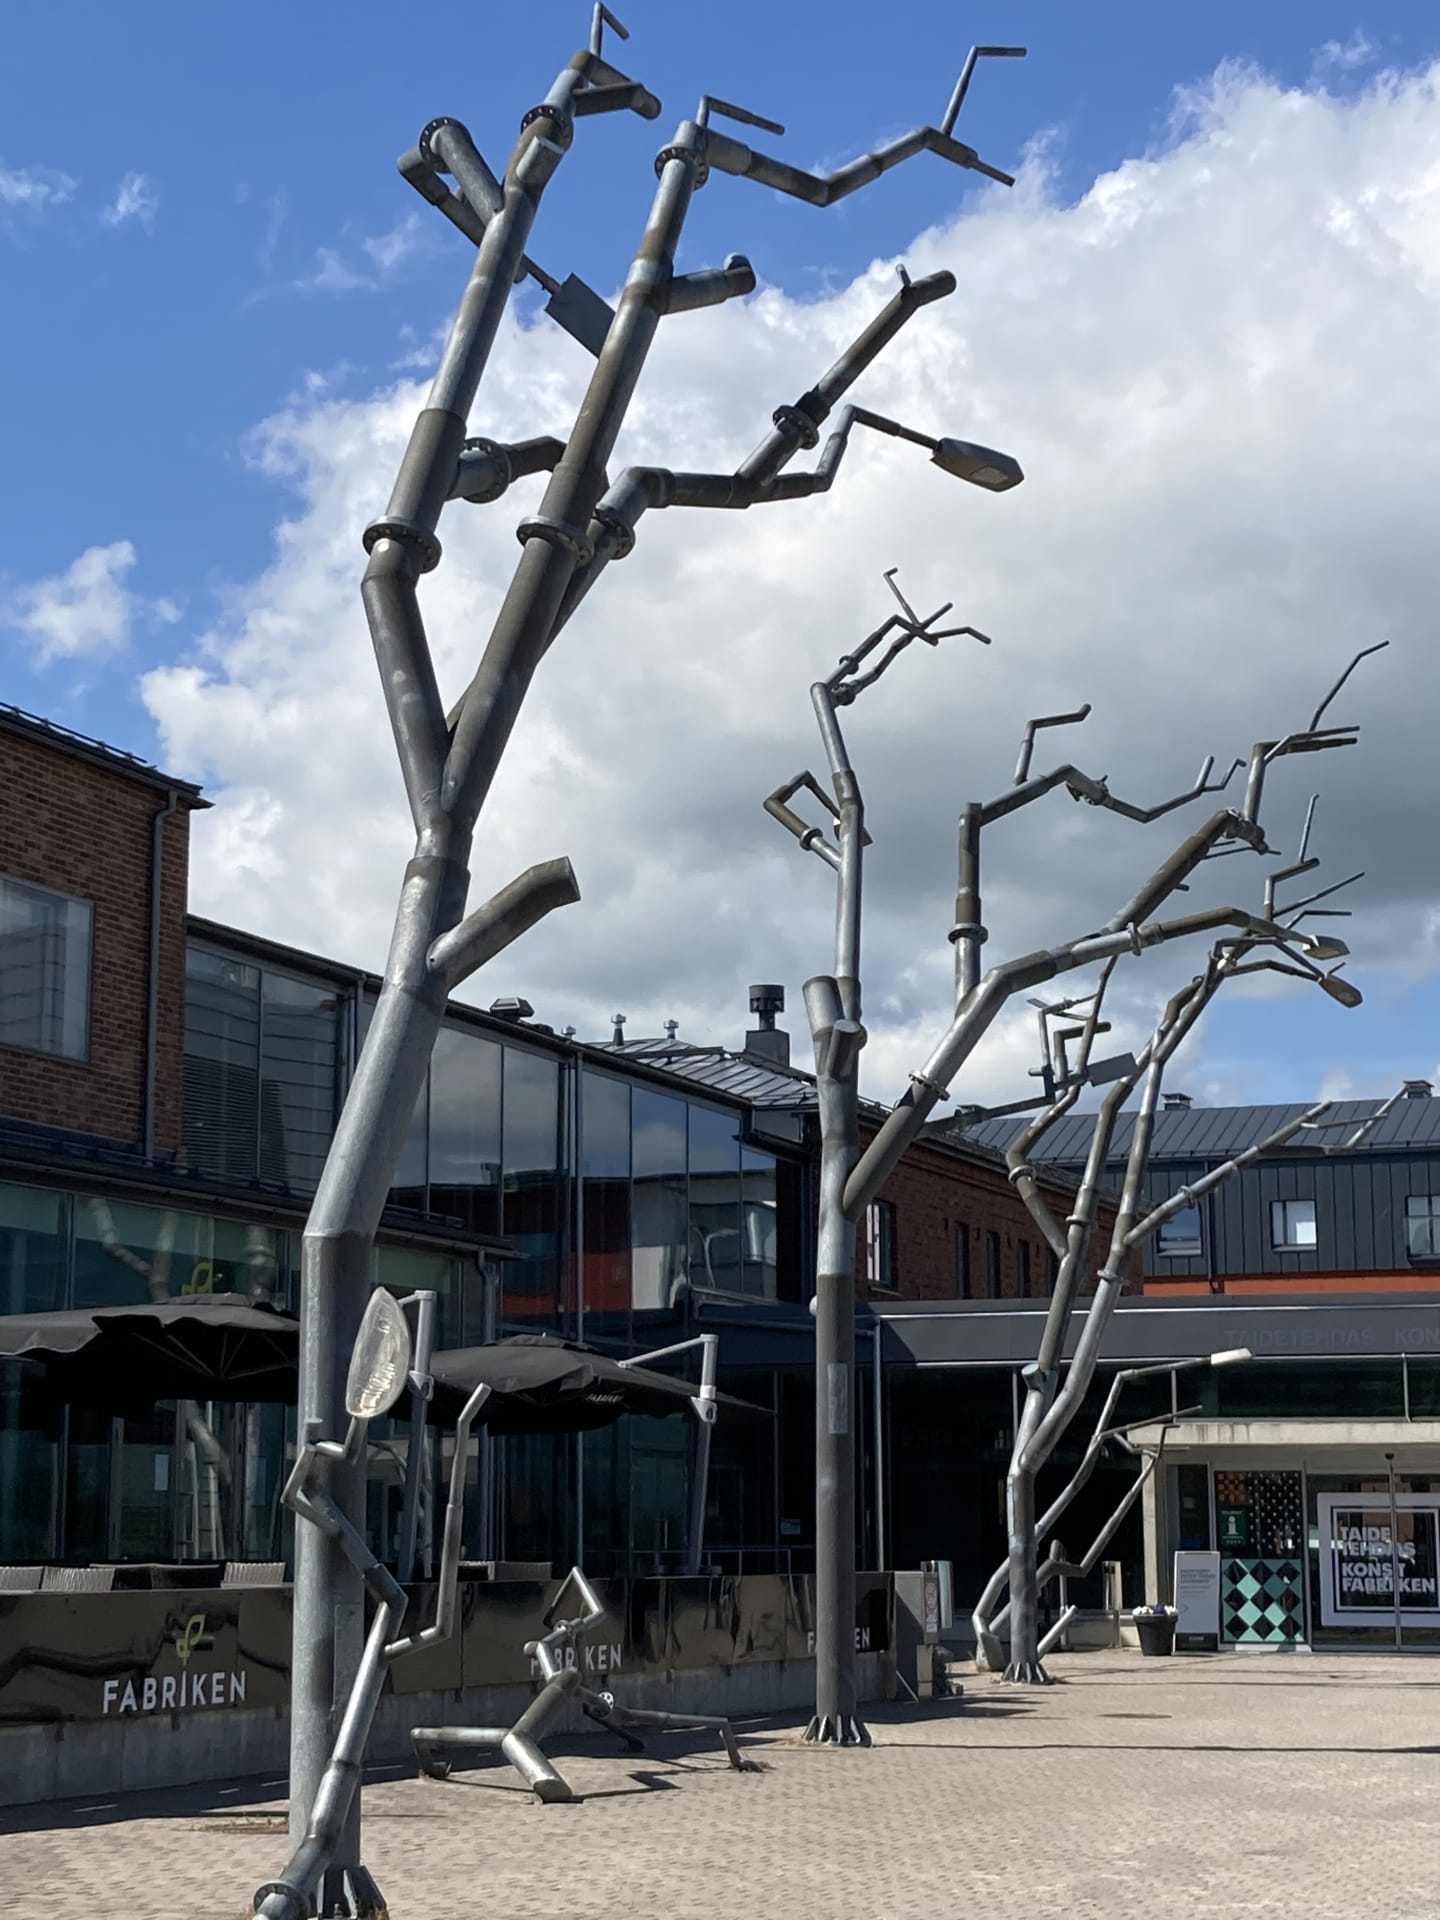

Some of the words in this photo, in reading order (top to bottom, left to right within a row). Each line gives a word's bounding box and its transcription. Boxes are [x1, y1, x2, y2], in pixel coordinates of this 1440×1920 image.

[1340, 1526, 1391, 1541] TAIDE
[1342, 1562, 1406, 1577] KONST
[1342, 1577, 1436, 1593] FABRIKEN
[530, 1643, 622, 1677] FBRKEN
[102, 1670, 246, 1714] FABRIKEN
